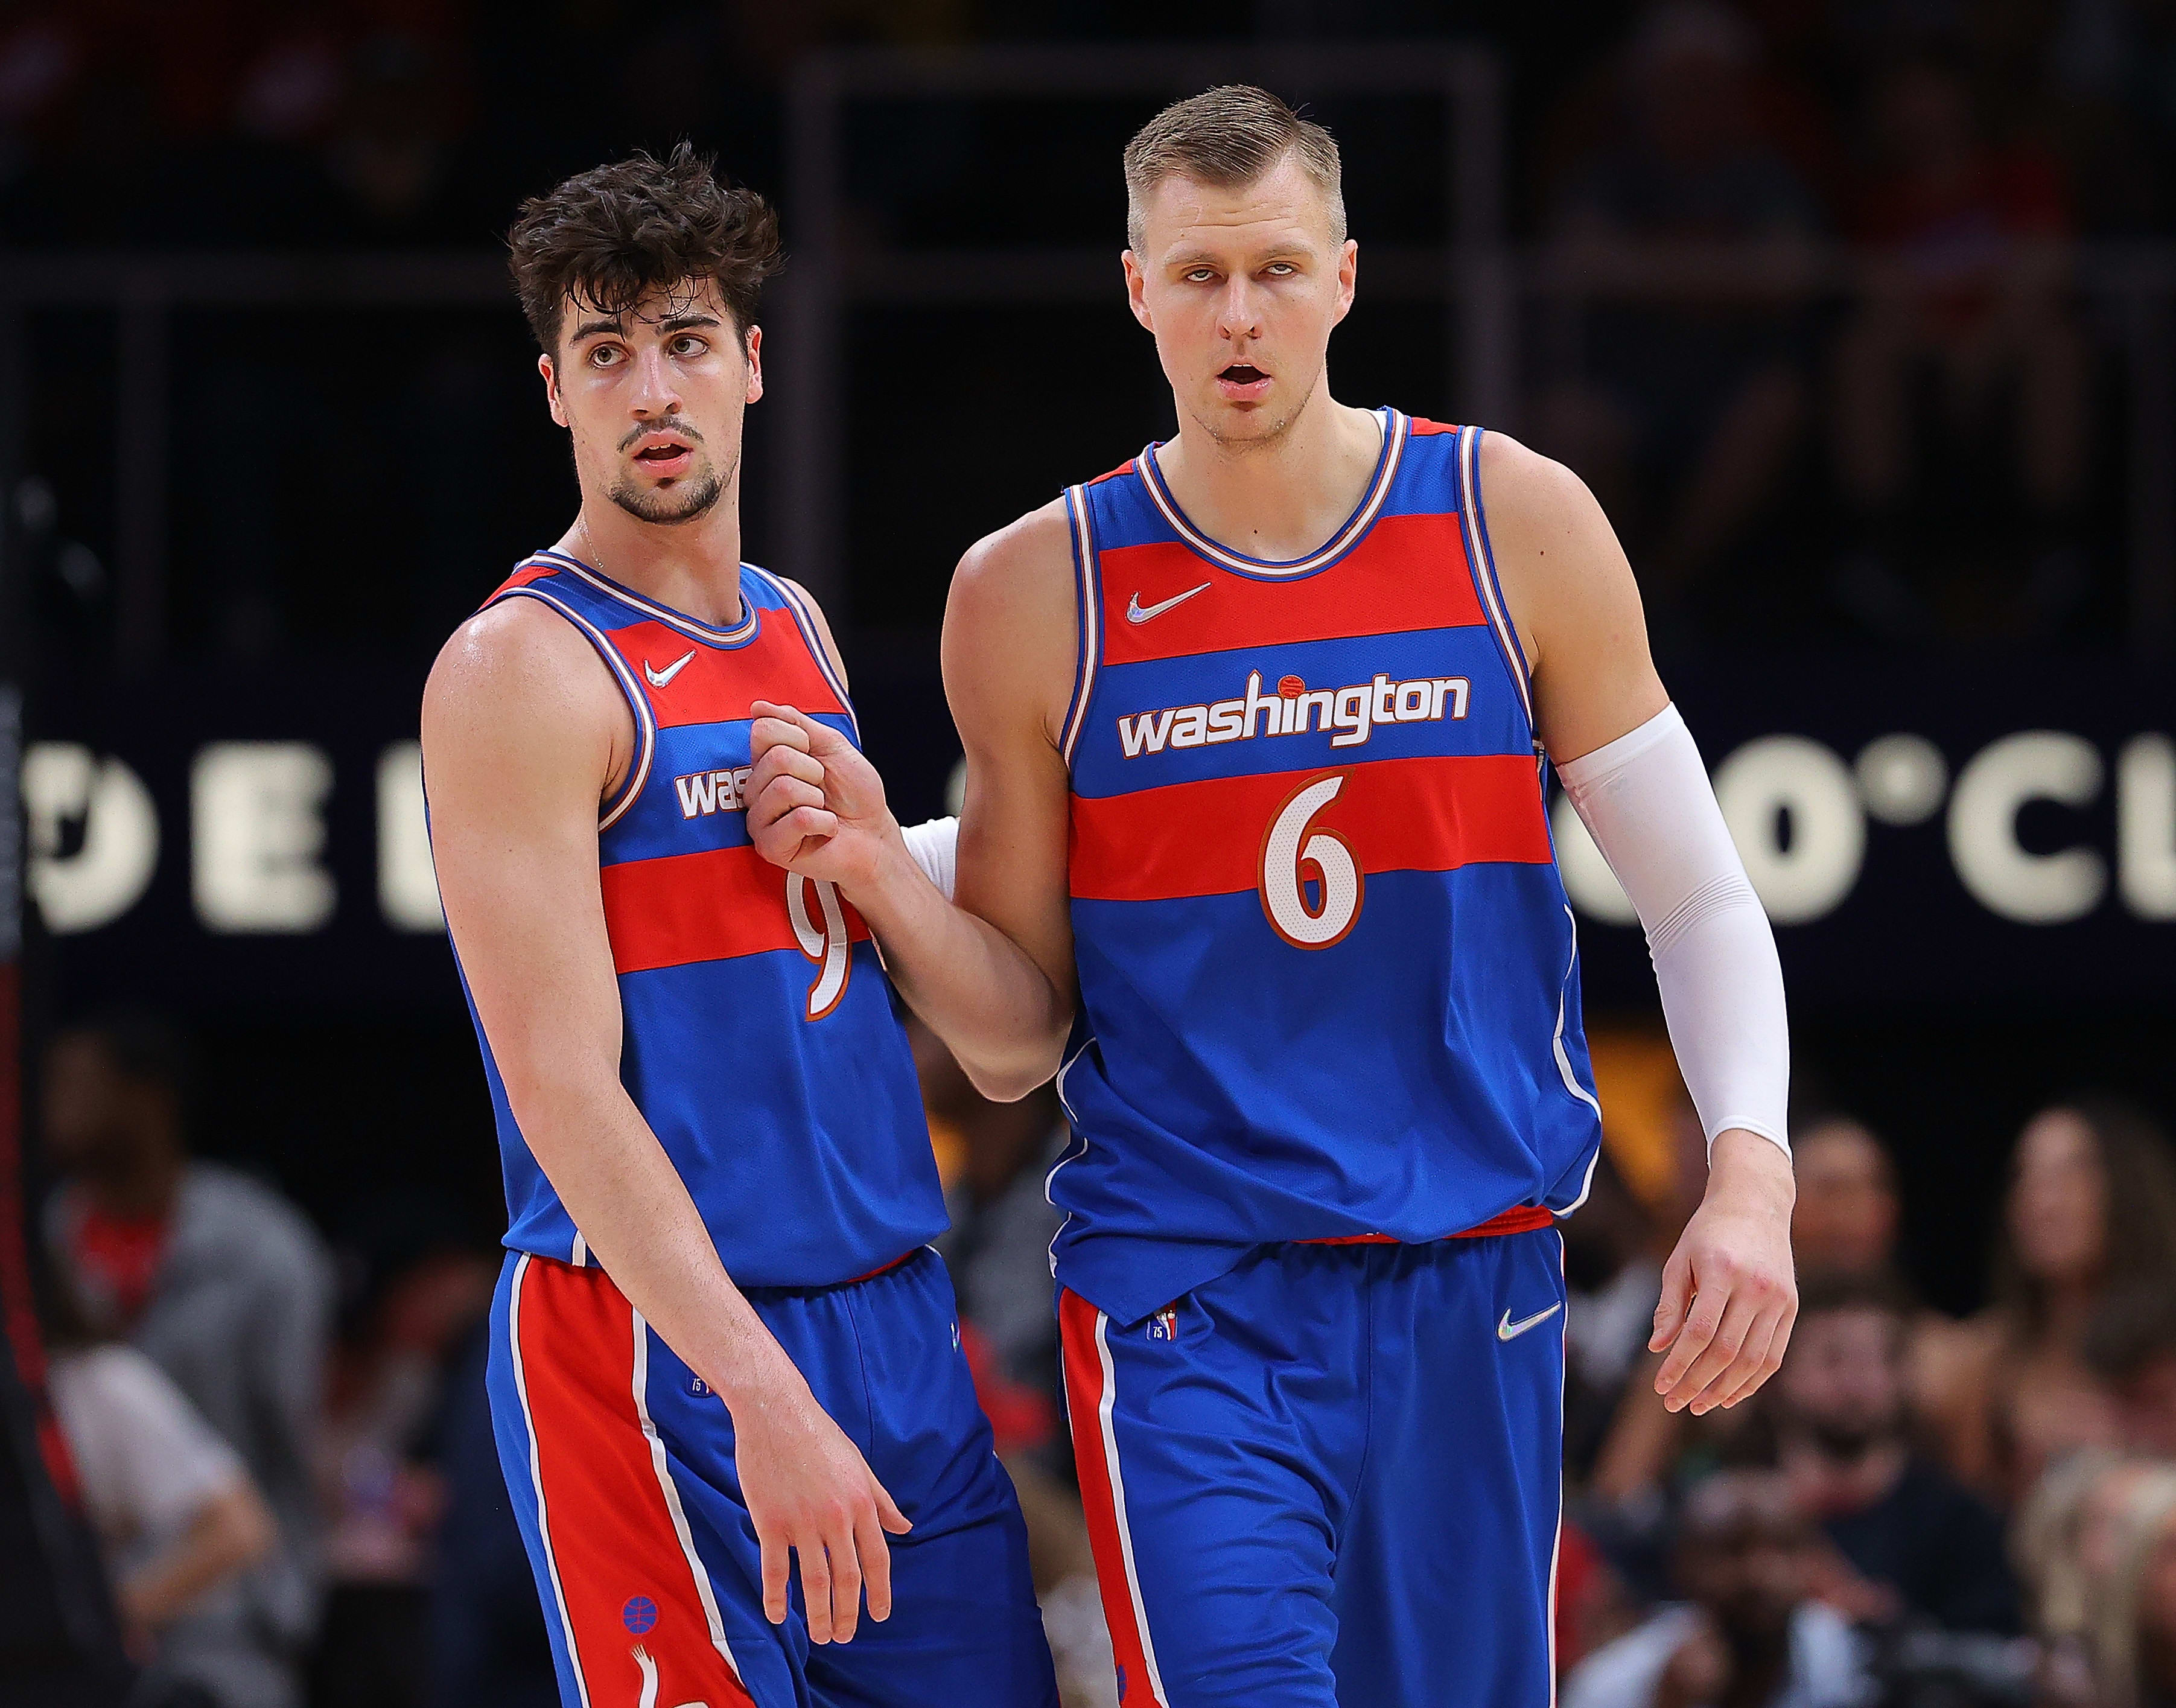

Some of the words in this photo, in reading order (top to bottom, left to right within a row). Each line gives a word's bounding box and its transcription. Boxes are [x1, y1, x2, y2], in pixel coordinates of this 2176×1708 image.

[1117, 669, 1470, 759] washington
[1258, 767, 1365, 951] 6
[786, 870, 853, 1021] 9
[1153, 1326, 1163, 1338] 75
